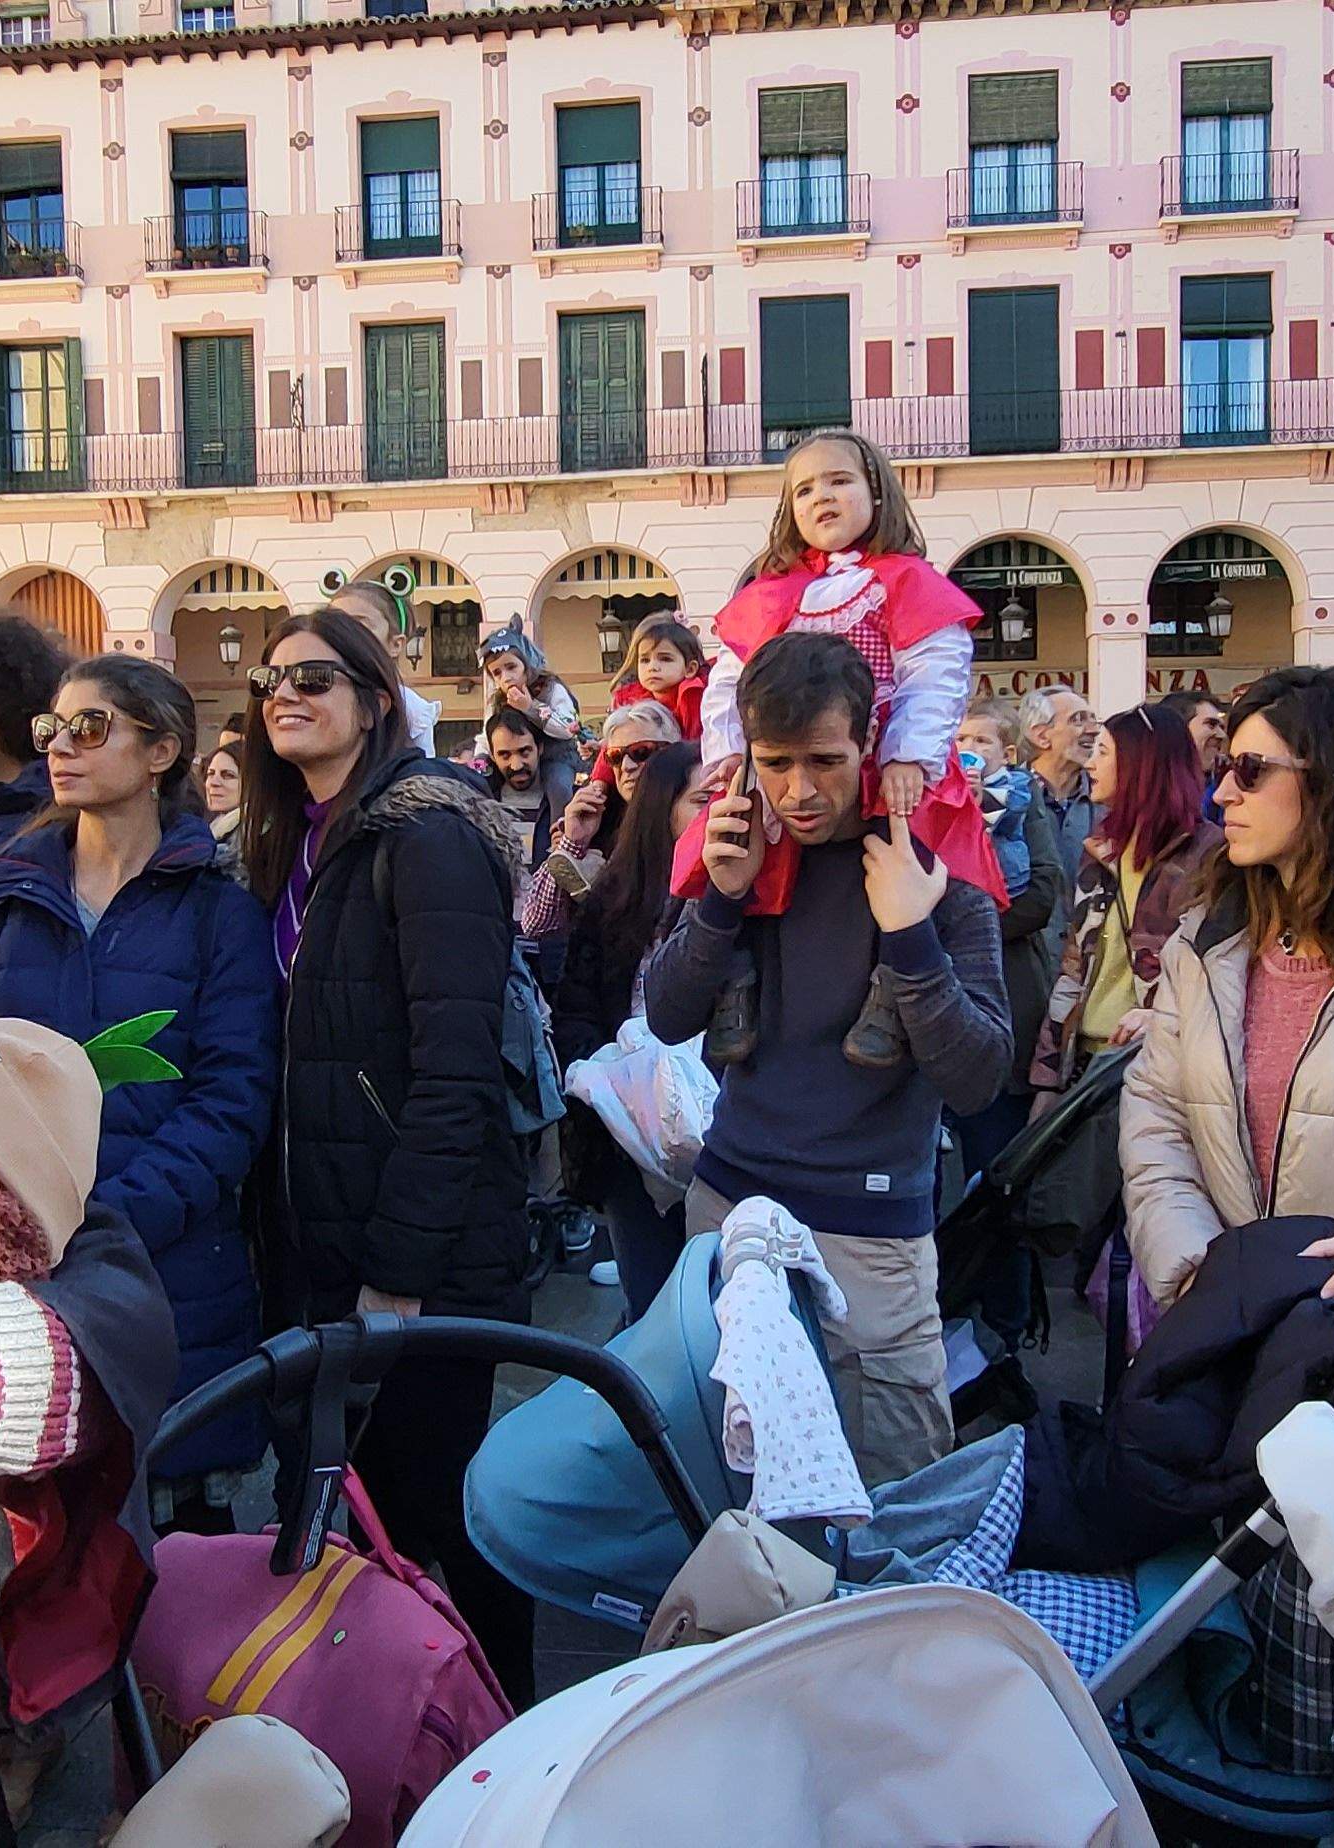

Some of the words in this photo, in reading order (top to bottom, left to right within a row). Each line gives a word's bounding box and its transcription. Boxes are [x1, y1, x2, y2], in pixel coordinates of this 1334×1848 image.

[1006, 570, 1017, 585] LA
[1019, 570, 1063, 585] CONFIANZA
[1210, 563, 1220, 578] LA
[1222, 563, 1267, 578] CONFIANZA
[978, 673, 993, 696] A
[1012, 670, 1210, 695] CONNZA
